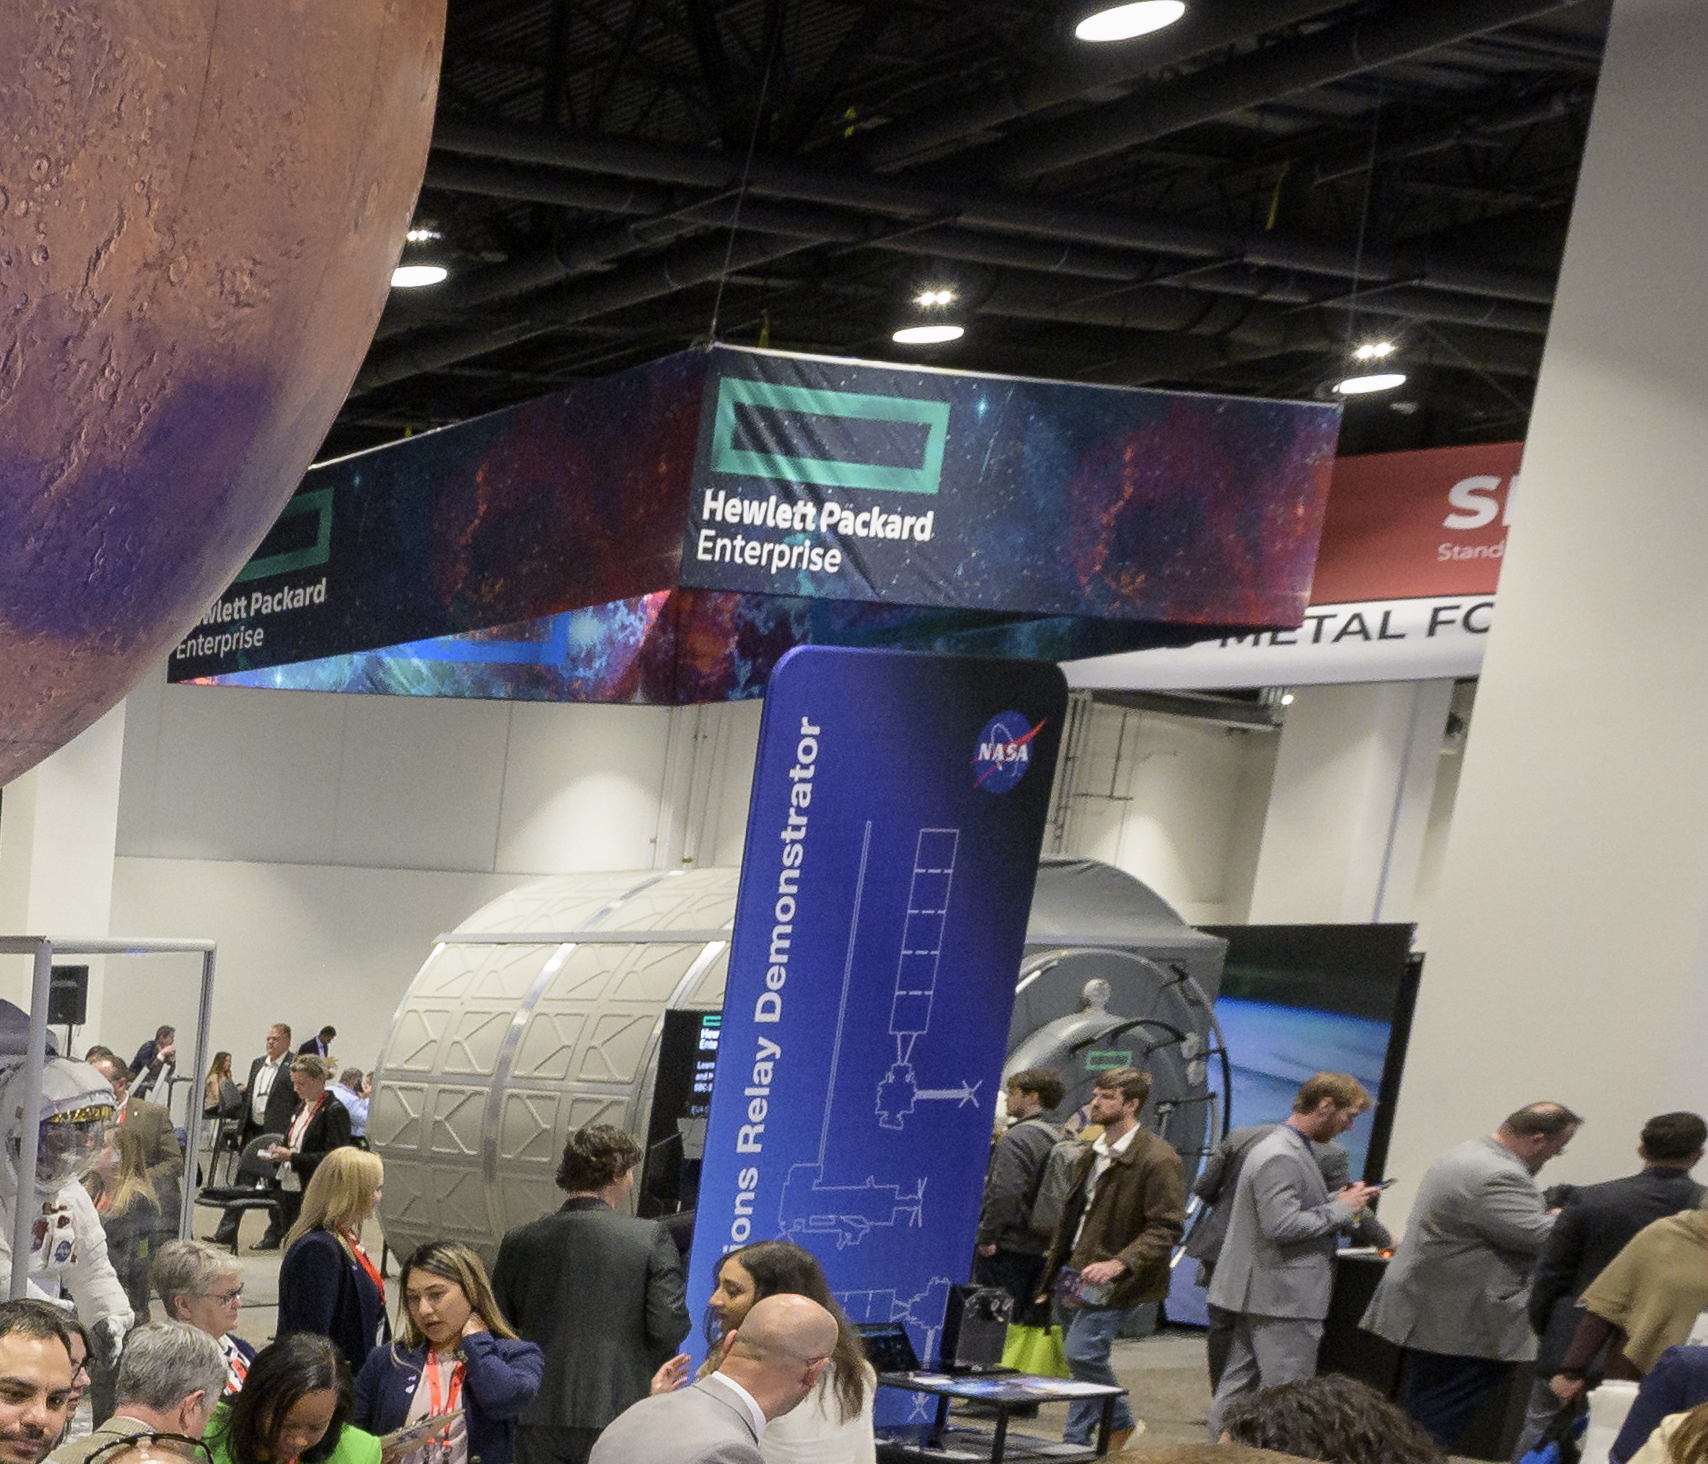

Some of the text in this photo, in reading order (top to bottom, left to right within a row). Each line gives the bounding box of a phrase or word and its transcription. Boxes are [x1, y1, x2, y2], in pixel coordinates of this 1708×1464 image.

[702, 488, 934, 542] Hewlett Packard
[697, 529, 842, 575] Enterprise
[197, 577, 327, 626] wlett Packard
[176, 626, 264, 660] Enterprise
[978, 743, 1028, 761] NASA
[754, 716, 821, 1023] Demonstrator
[736, 1036, 782, 1153] Relay
